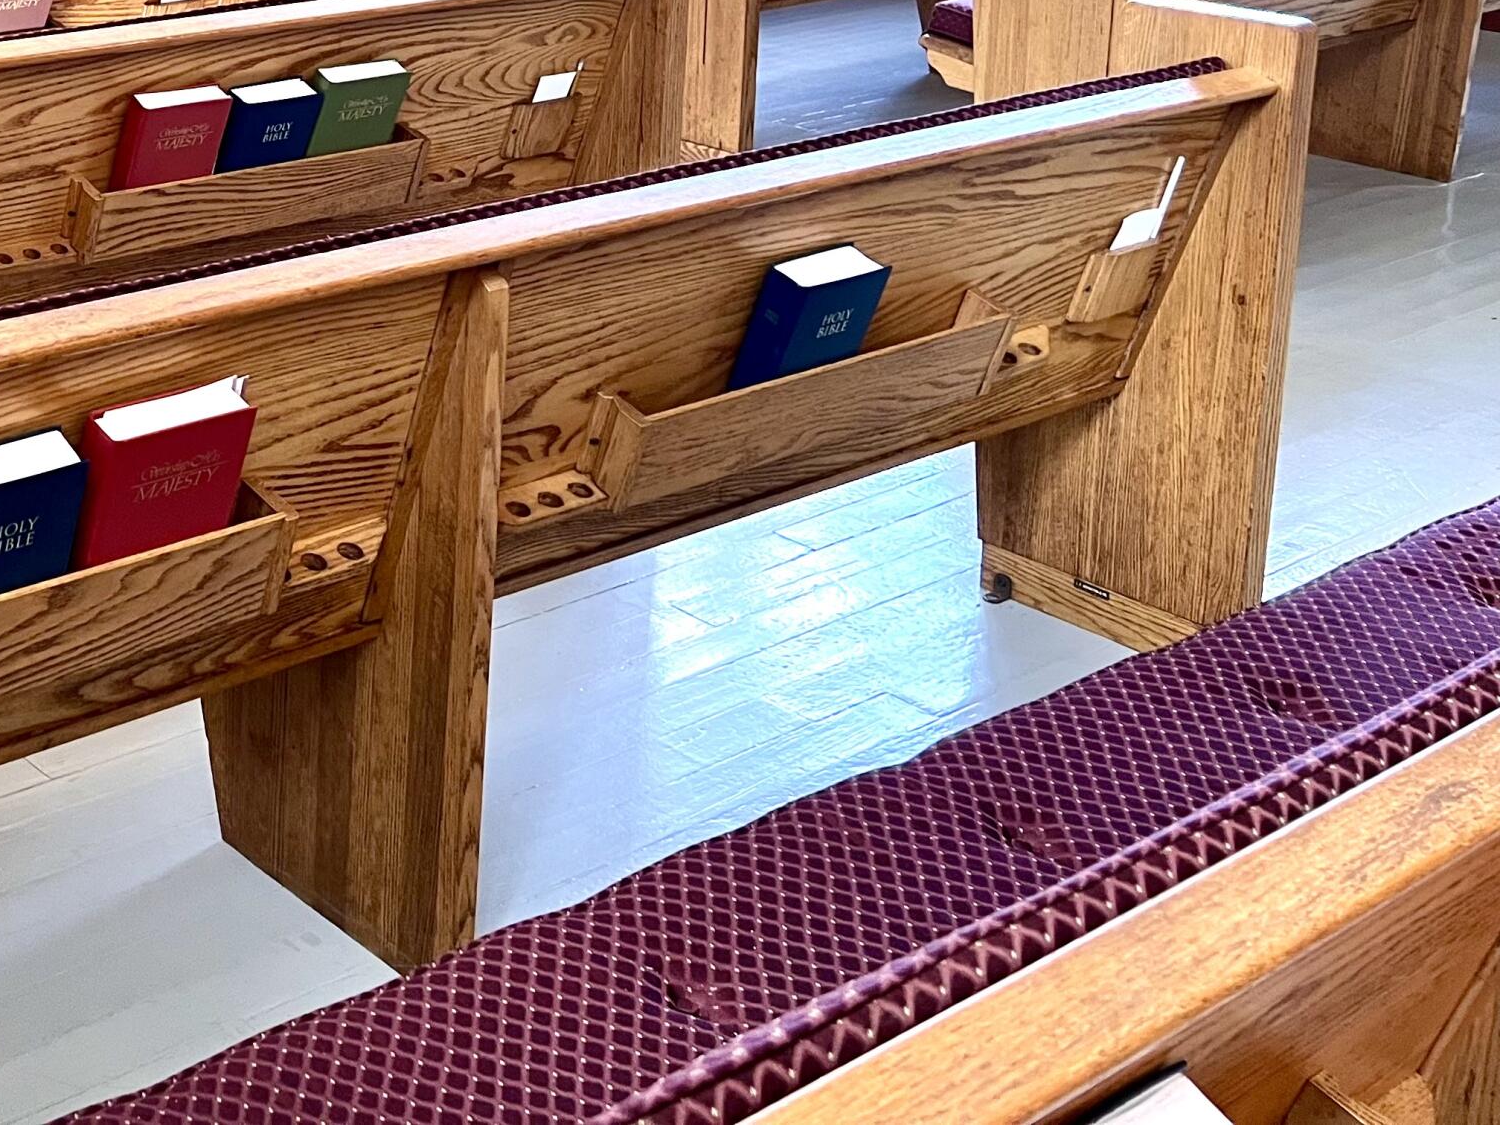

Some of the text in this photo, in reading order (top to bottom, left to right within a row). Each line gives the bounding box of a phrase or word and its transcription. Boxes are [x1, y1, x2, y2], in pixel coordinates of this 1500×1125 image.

[265, 121, 294, 133] HOLY
[262, 130, 289, 143] BIBLE
[822, 308, 855, 326] HOLY
[816, 320, 849, 338] BIBLE
[133, 465, 220, 502] MAJESTY
